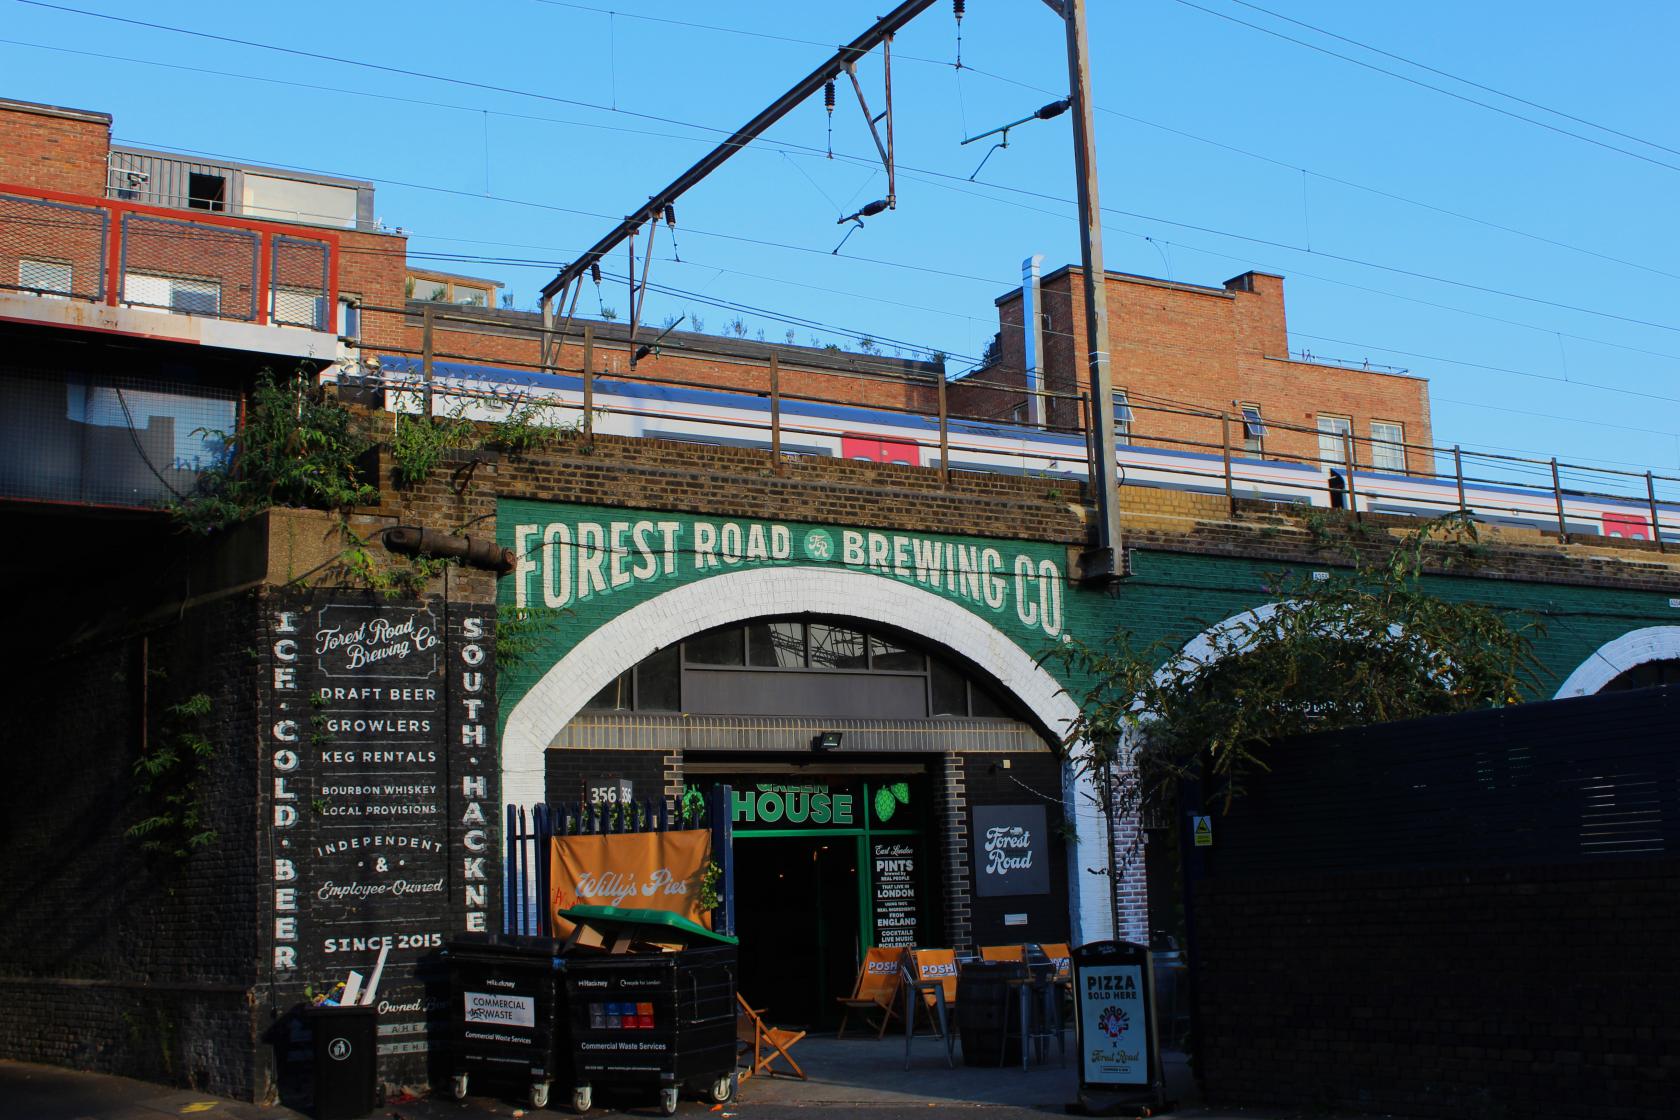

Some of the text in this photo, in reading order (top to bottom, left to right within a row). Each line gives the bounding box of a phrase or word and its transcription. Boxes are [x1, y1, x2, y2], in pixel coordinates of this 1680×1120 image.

[515, 521, 681, 618] FOREST
[694, 522, 792, 573] ROAD
[843, 530, 1006, 611] BREWING
[1016, 554, 1072, 644] CO.
[315, 614, 414, 655] Forest Road
[274, 611, 298, 690] ICE
[346, 644, 410, 670] Brewing
[462, 617, 487, 748] SOUTH
[320, 687, 436, 701] DRAFT BEER
[327, 719, 431, 732] GROWLERS
[322, 751, 436, 763] KEG RENTALS
[273, 719, 299, 828] COLD
[322, 785, 436, 796] BOURBON WHISKEY
[591, 786, 617, 804] 356
[322, 805, 437, 816] LOCAL PROVISIONS
[731, 790, 853, 824] HOUSE
[317, 835, 442, 857] INDEPENDENT
[985, 826, 1031, 852] Forest
[463, 775, 489, 934] HACKNE
[985, 850, 1033, 875] Road
[375, 857, 389, 873] &
[876, 859, 914, 872] PINTS
[317, 878, 443, 900] Employee-Owned
[575, 871, 637, 907] Willy's
[641, 867, 688, 897] Pies
[877, 888, 915, 898] LONDON
[274, 858, 299, 970] BEER
[877, 917, 916, 927] ENGLAND
[881, 929, 913, 937] COCKTAILS
[324, 933, 441, 953] SINCE 2015
[868, 960, 898, 971] POSH
[920, 963, 956, 976] POSH
[1087, 975, 1136, 990] PIZZA
[473, 997, 526, 1010] COMMERCIAL
[1087, 991, 1137, 1000] SOLD HERE
[378, 998, 421, 1014] Owned
[487, 1009, 513, 1020] WASTE
[464, 1031, 495, 1040] Commercial
[581, 1042, 666, 1051] Commercial Waste Services
